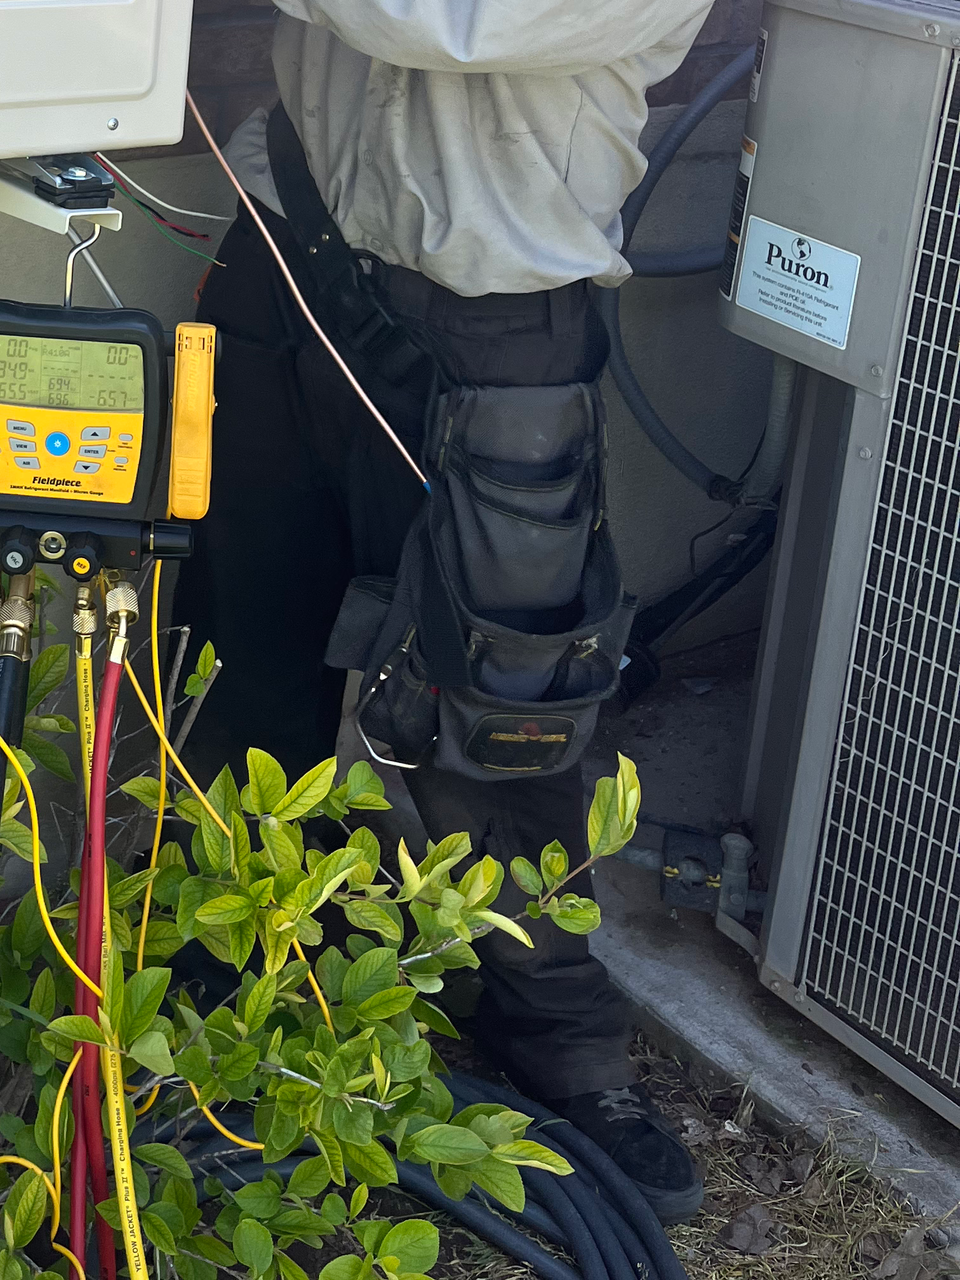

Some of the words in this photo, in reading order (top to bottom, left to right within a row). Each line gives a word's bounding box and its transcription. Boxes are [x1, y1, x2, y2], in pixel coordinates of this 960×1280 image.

[32, 476, 82, 487] Fieldpiece
[117, 1128, 125, 1162] Charging
[131, 1240, 141, 1273] YELLOW
